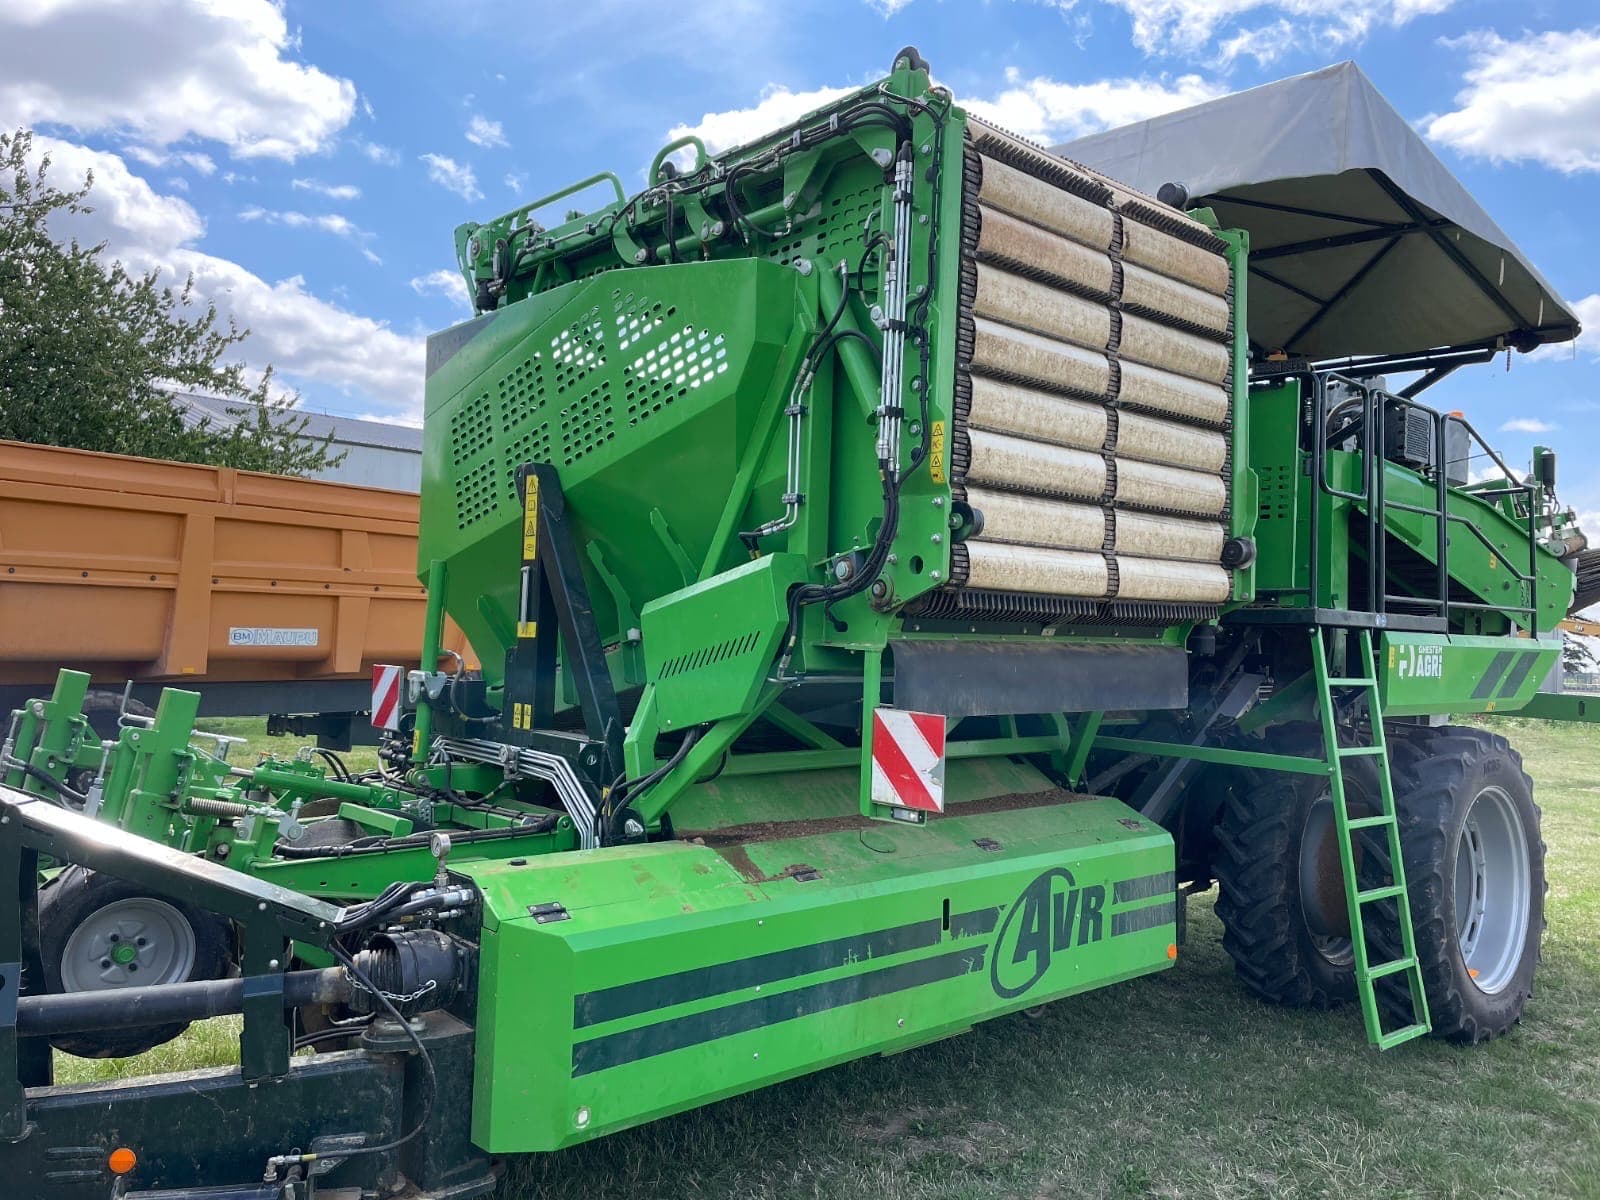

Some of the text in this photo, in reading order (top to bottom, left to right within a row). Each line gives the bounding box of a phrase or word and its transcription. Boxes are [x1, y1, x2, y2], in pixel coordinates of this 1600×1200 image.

[233, 629, 317, 645] BM MAUPU
[991, 867, 1106, 999] AVR
